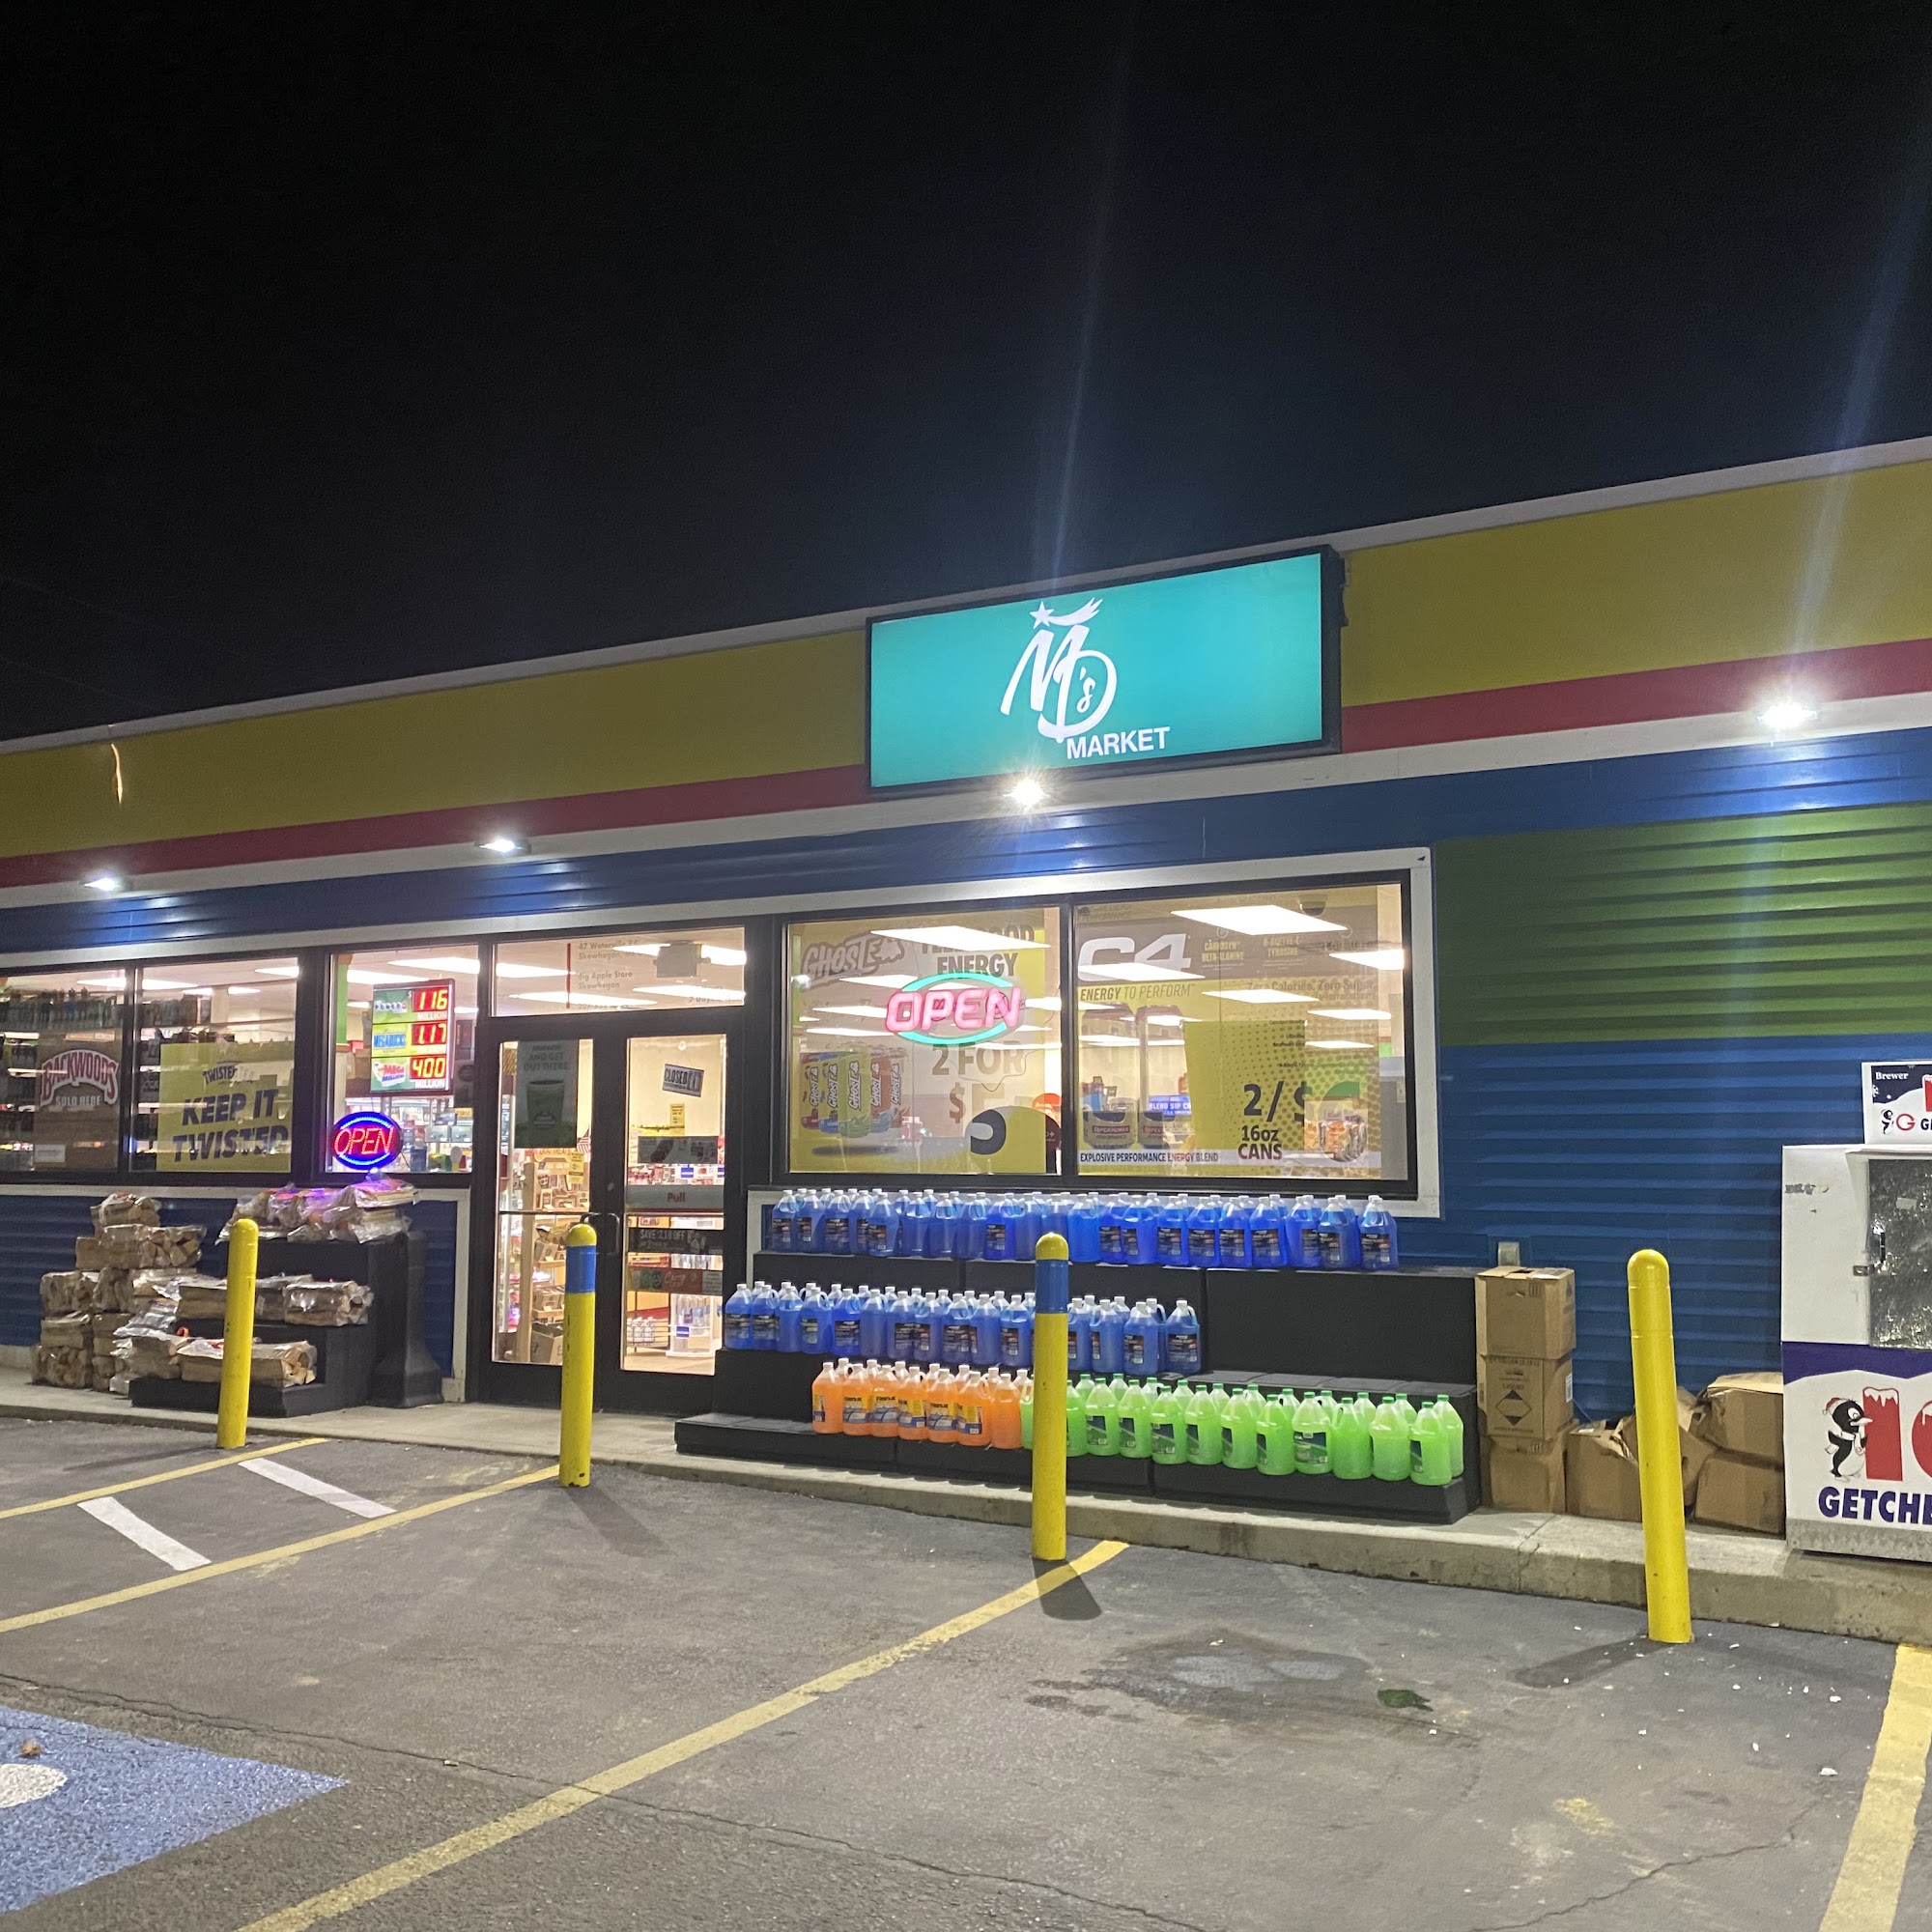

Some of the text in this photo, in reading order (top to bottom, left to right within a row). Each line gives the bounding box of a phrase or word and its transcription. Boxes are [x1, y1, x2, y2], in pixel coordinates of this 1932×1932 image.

[1066, 726, 1170, 759] MARKET
[802, 933, 881, 985] GHOST
[937, 952, 1018, 978] ENERGY
[1078, 933, 1191, 981] C4
[579, 981, 619, 991] Skowhegan
[591, 972, 612, 980] Apple
[1318, 980, 1341, 990] Zero
[419, 989, 448, 1010] 116
[1080, 987, 1122, 1001] ENERGY
[1124, 986, 1136, 999] TO
[416, 1010, 447, 1020] MILLION
[886, 987, 1021, 1032] OPEN
[412, 1058, 446, 1078] 400
[932, 1041, 1025, 1075] 2 FOR
[42, 1051, 117, 1101] BACKWOODS
[664, 1067, 689, 1086] CLOSED
[1875, 1071, 1909, 1080] Brewer
[810, 1076, 819, 1107] GHOST
[828, 1076, 838, 1109] GHOST
[848, 1074, 862, 1111] GHOST
[870, 1075, 881, 1107] GHOST
[891, 1074, 900, 1105] GHOST
[182, 1089, 280, 1126] KEEP IT
[172, 1124, 289, 1163] TWISTED
[334, 1127, 394, 1155] OPEN
[1241, 1124, 1279, 1142] 16oz
[1080, 1152, 1218, 1162] EXPLOSIVE PERFORMANCE ENERGY BLEND
[1237, 1143, 1283, 1160] CANS
[667, 1192, 686, 1203] Pull
